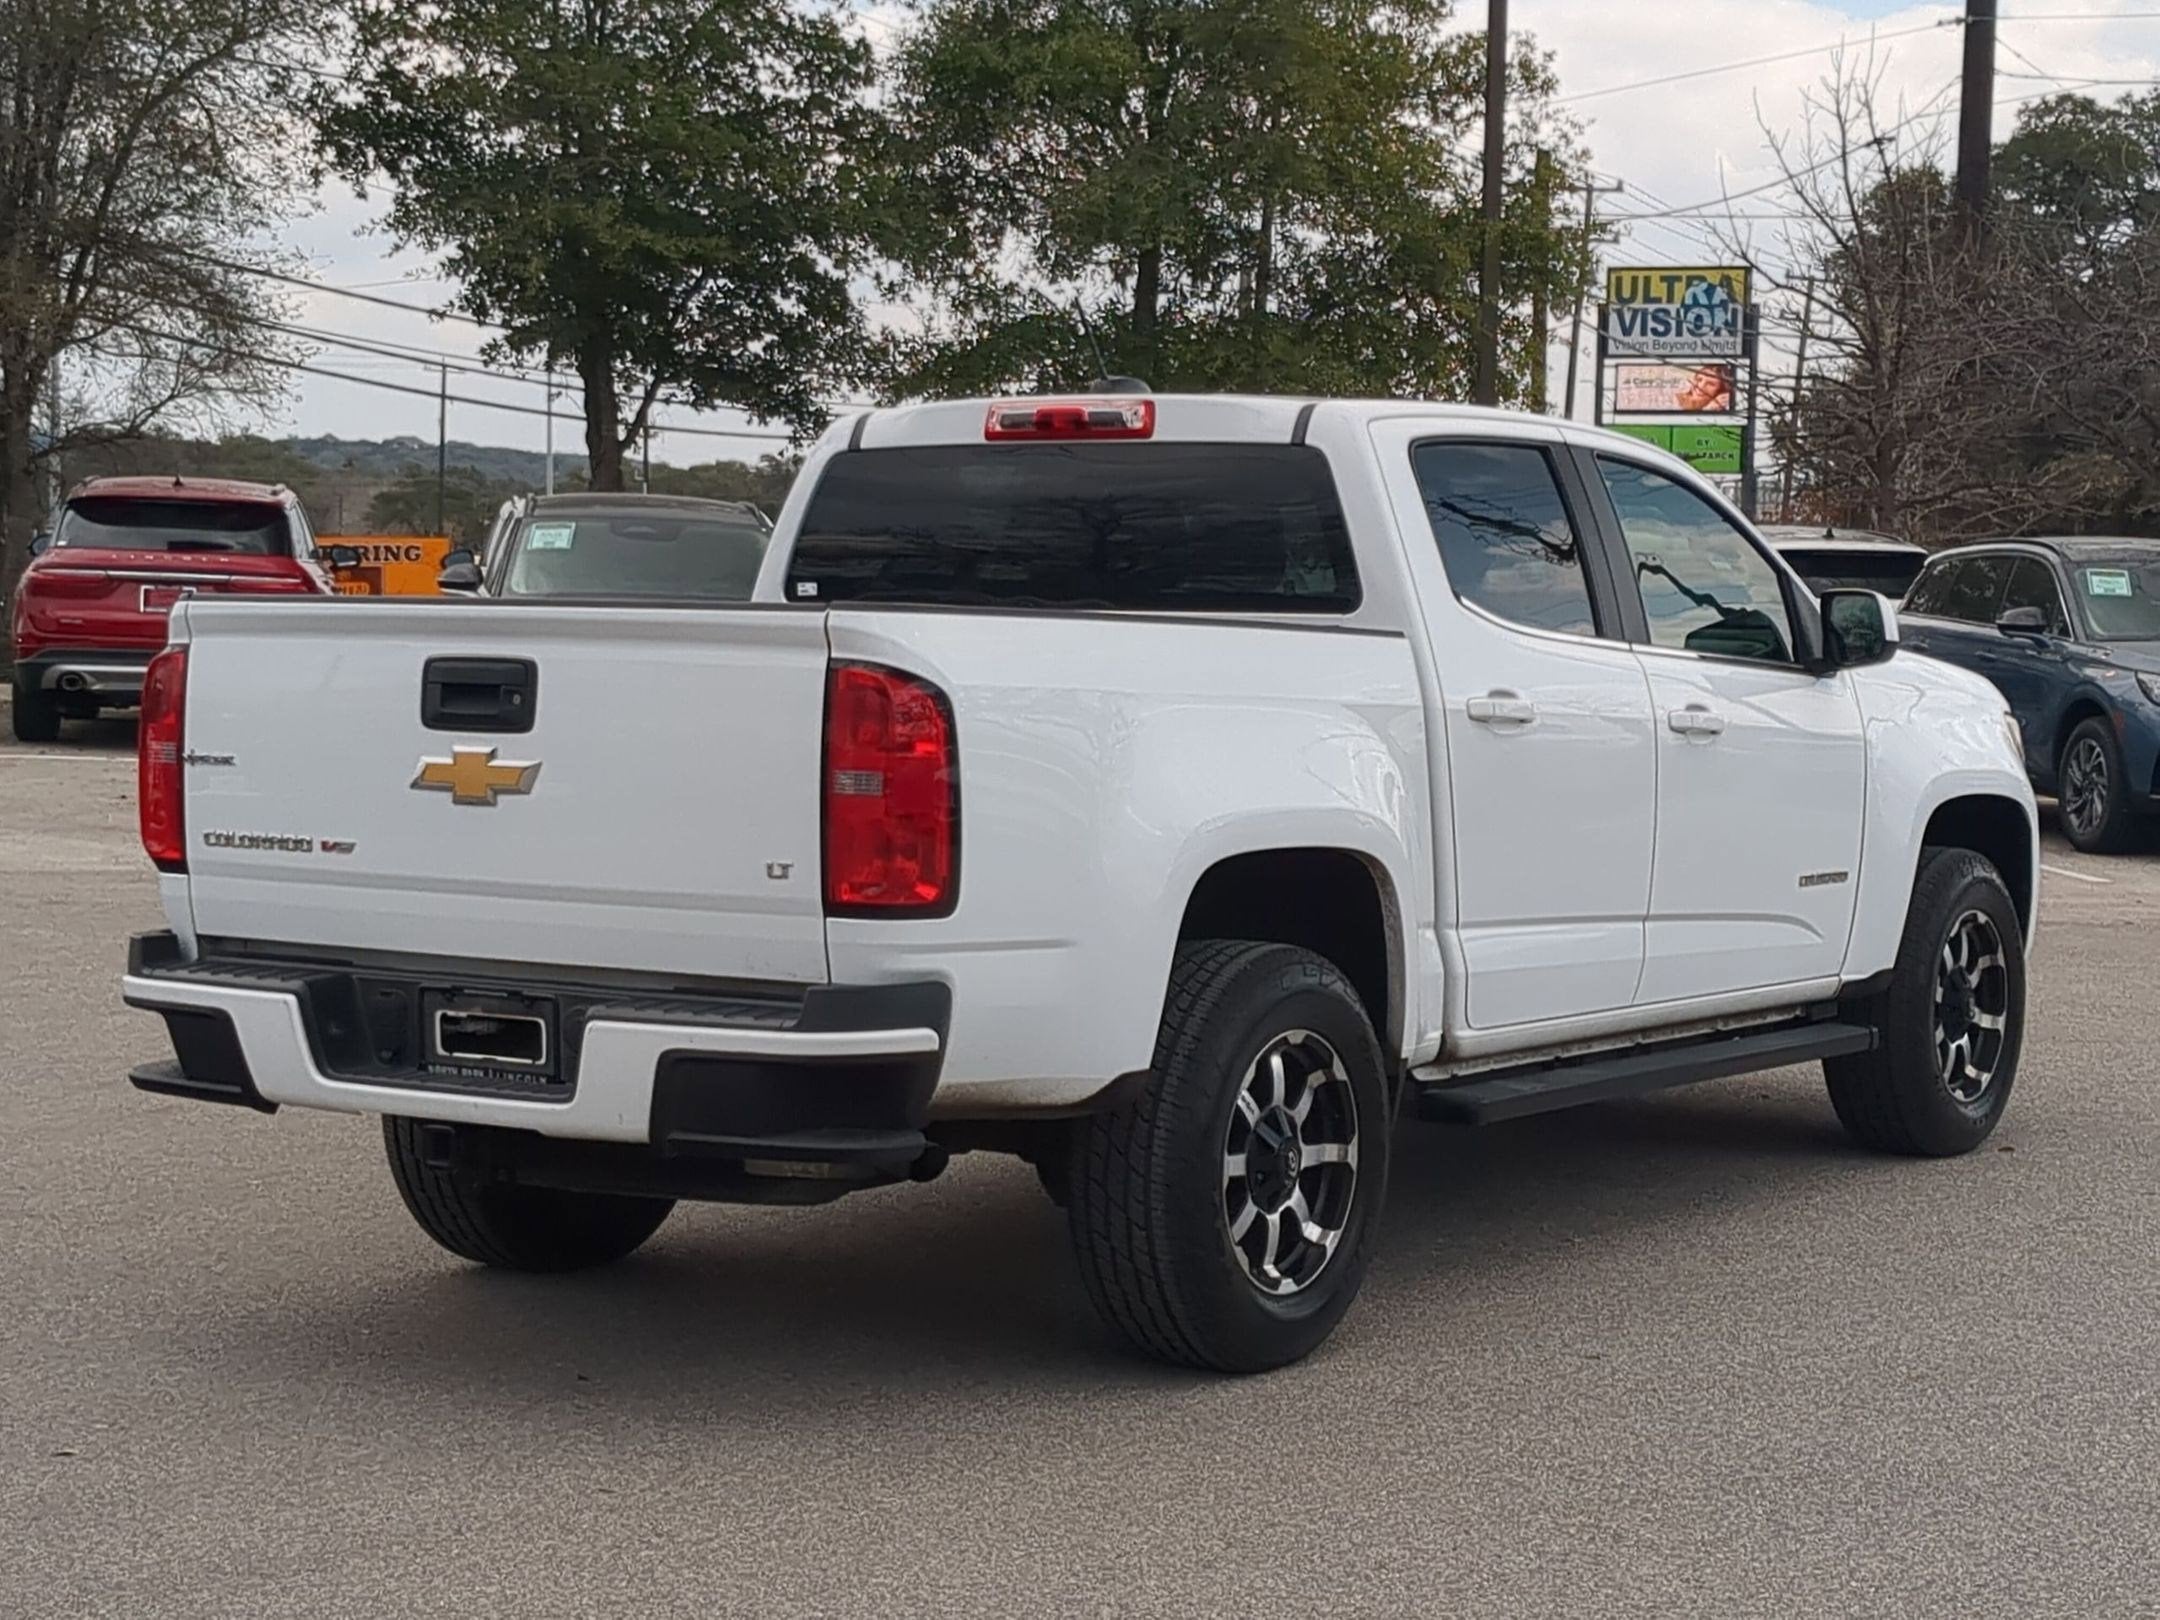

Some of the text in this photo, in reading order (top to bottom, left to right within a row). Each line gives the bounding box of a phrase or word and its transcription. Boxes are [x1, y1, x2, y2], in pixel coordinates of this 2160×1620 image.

[1615, 275, 1738, 305] ULTRA
[1615, 307, 1738, 337] VISION
[1614, 339, 1737, 352] Vision Beyond Limits
[203, 831, 314, 852] COLORADO
[766, 862, 794, 880] LT
